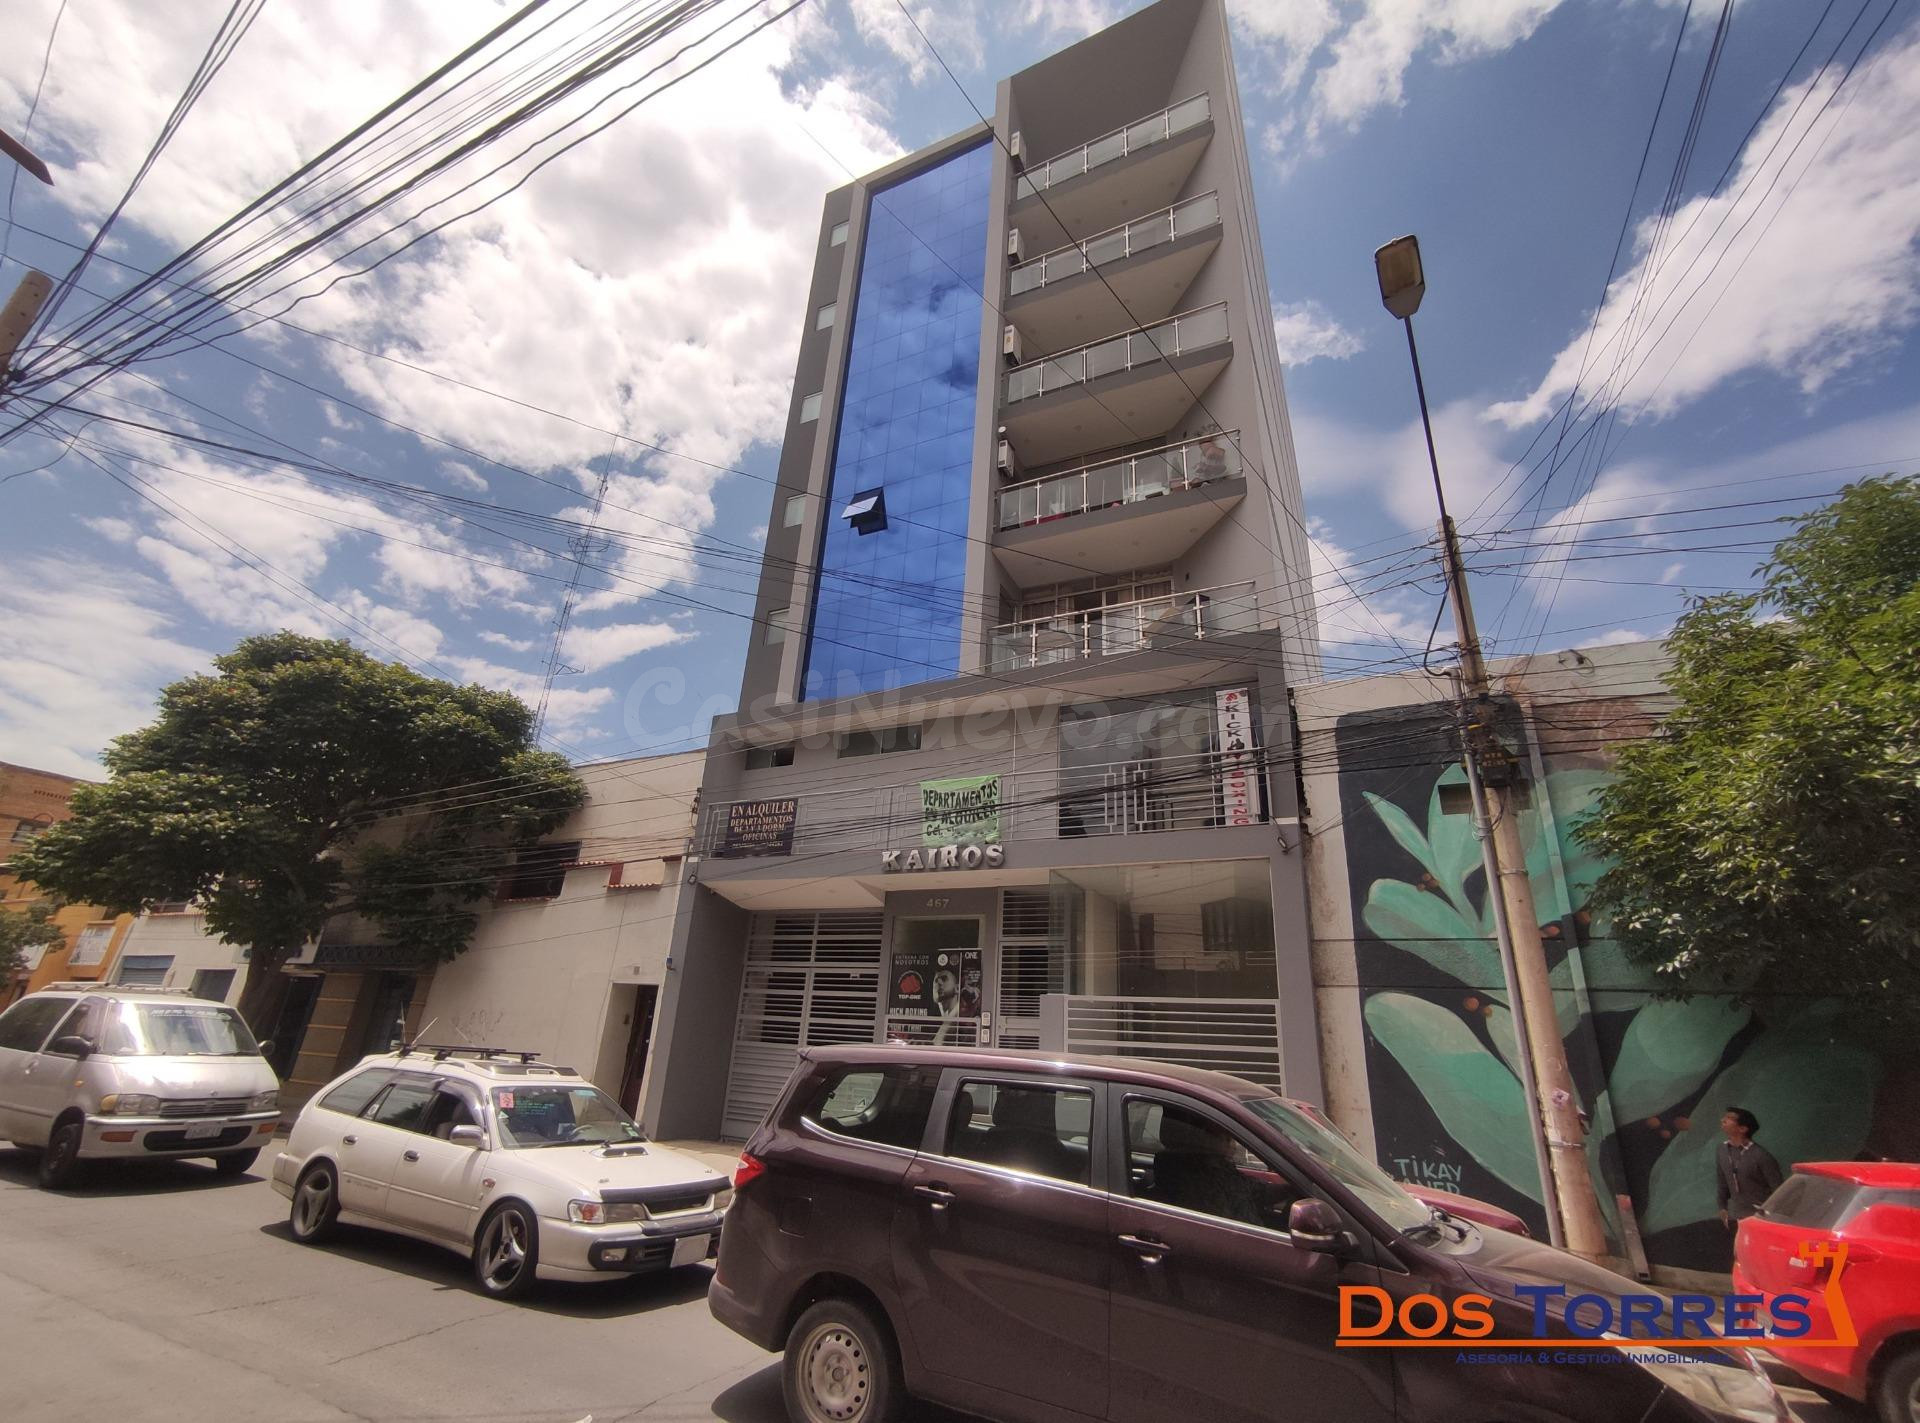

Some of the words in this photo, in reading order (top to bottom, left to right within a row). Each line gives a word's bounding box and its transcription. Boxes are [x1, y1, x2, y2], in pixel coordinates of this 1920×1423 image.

[923, 780, 998, 808] DEPARTAMENTOS
[732, 805, 744, 817] EN
[746, 801, 794, 817] ALQUILER
[730, 815, 793, 827] DEPARTAMENTOS
[742, 832, 777, 841] OFICINAS
[882, 844, 1005, 871] KAIROS
[926, 898, 950, 908] 467
[1393, 1155, 1462, 1182] TIKAY
